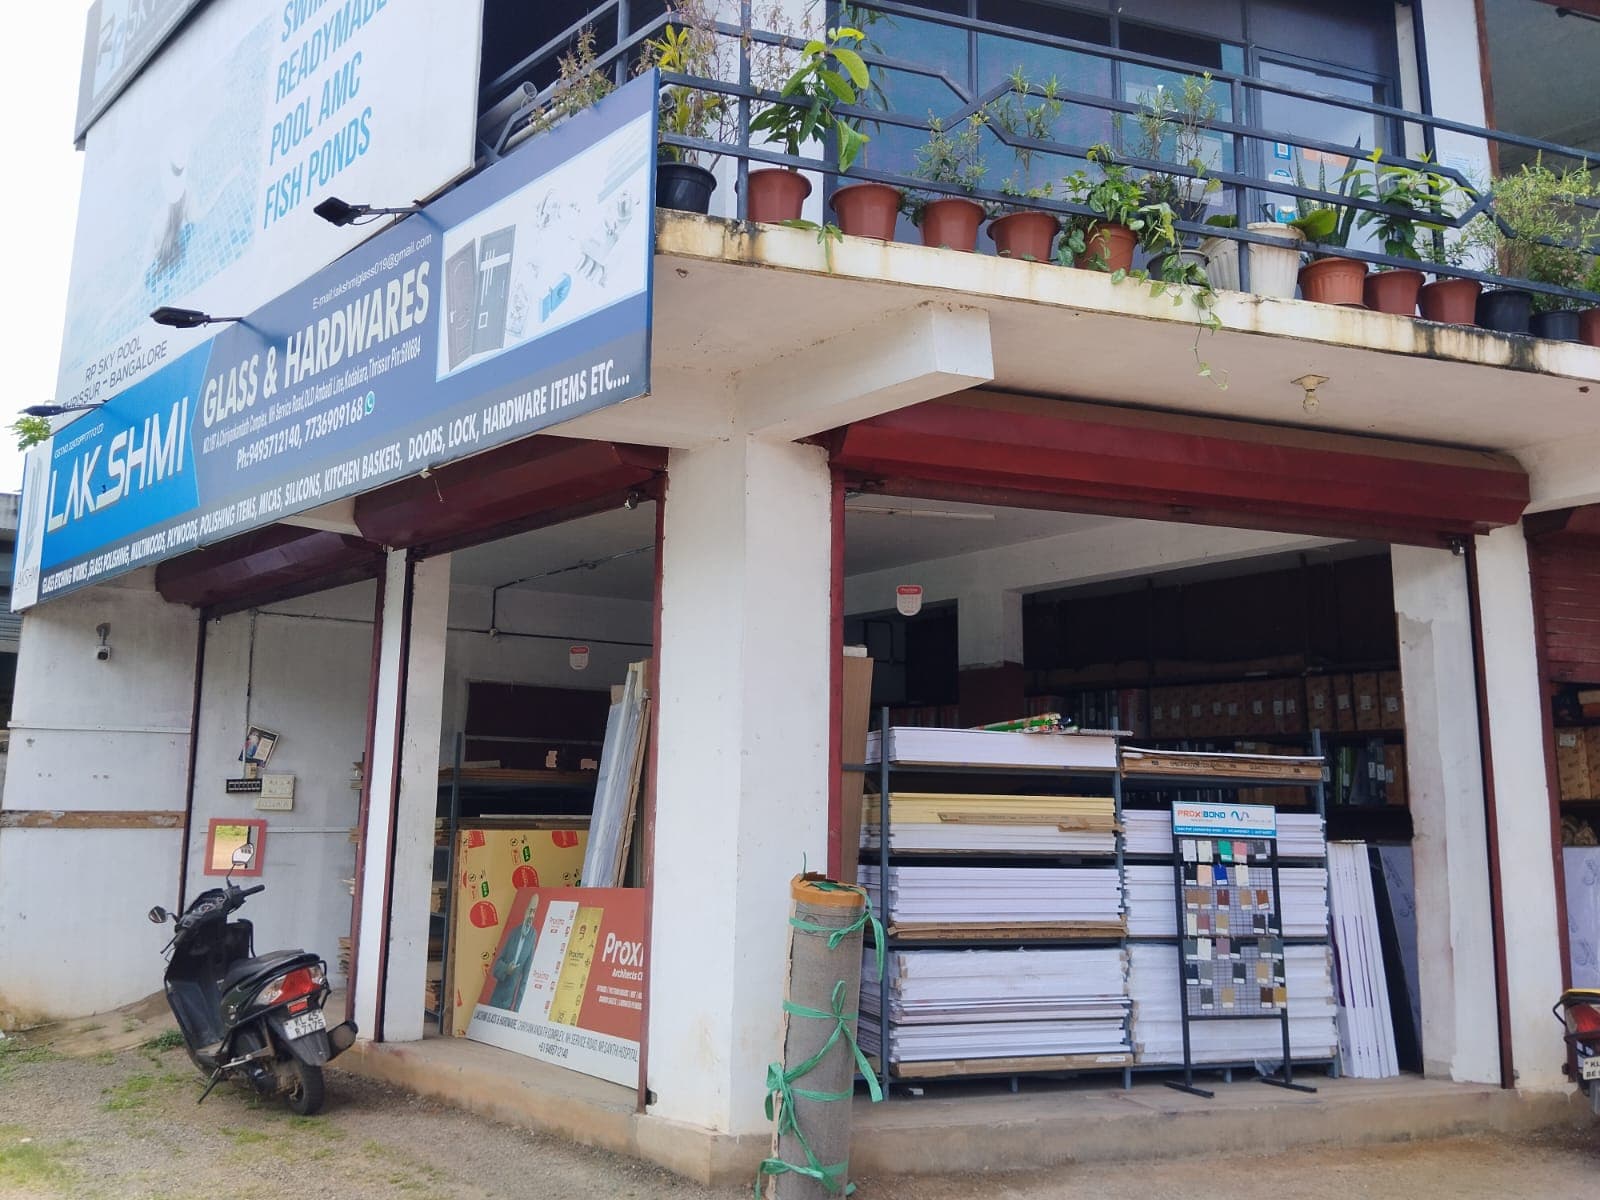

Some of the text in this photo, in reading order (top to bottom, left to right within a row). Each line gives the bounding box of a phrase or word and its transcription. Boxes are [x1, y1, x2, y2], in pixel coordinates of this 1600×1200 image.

[263, 106, 372, 230] FISH PONDS
[270, 51, 362, 166] POOL AMC
[85, 336, 142, 383] RP SKY POOL
[109, 340, 168, 388] BANGALORE
[203, 261, 430, 428] GLASS & HARDWARES
[47, 396, 188, 533] LAKSHMI
[166, 518, 199, 549] PLYWOODS,
[199, 506, 236, 537] POLISHING
[236, 496, 257, 524] ITEMS,
[258, 488, 283, 516] MICAS,
[285, 472, 322, 507] SILICONS,
[324, 460, 361, 493] KITCHEN
[362, 442, 403, 480] BASKETS,
[408, 425, 446, 462] DOORS,
[448, 412, 480, 449] LOCK,
[482, 384, 547, 436] HARDWARE
[550, 375, 587, 411] ITEMS
[304, 396, 363, 443] 7736909168
